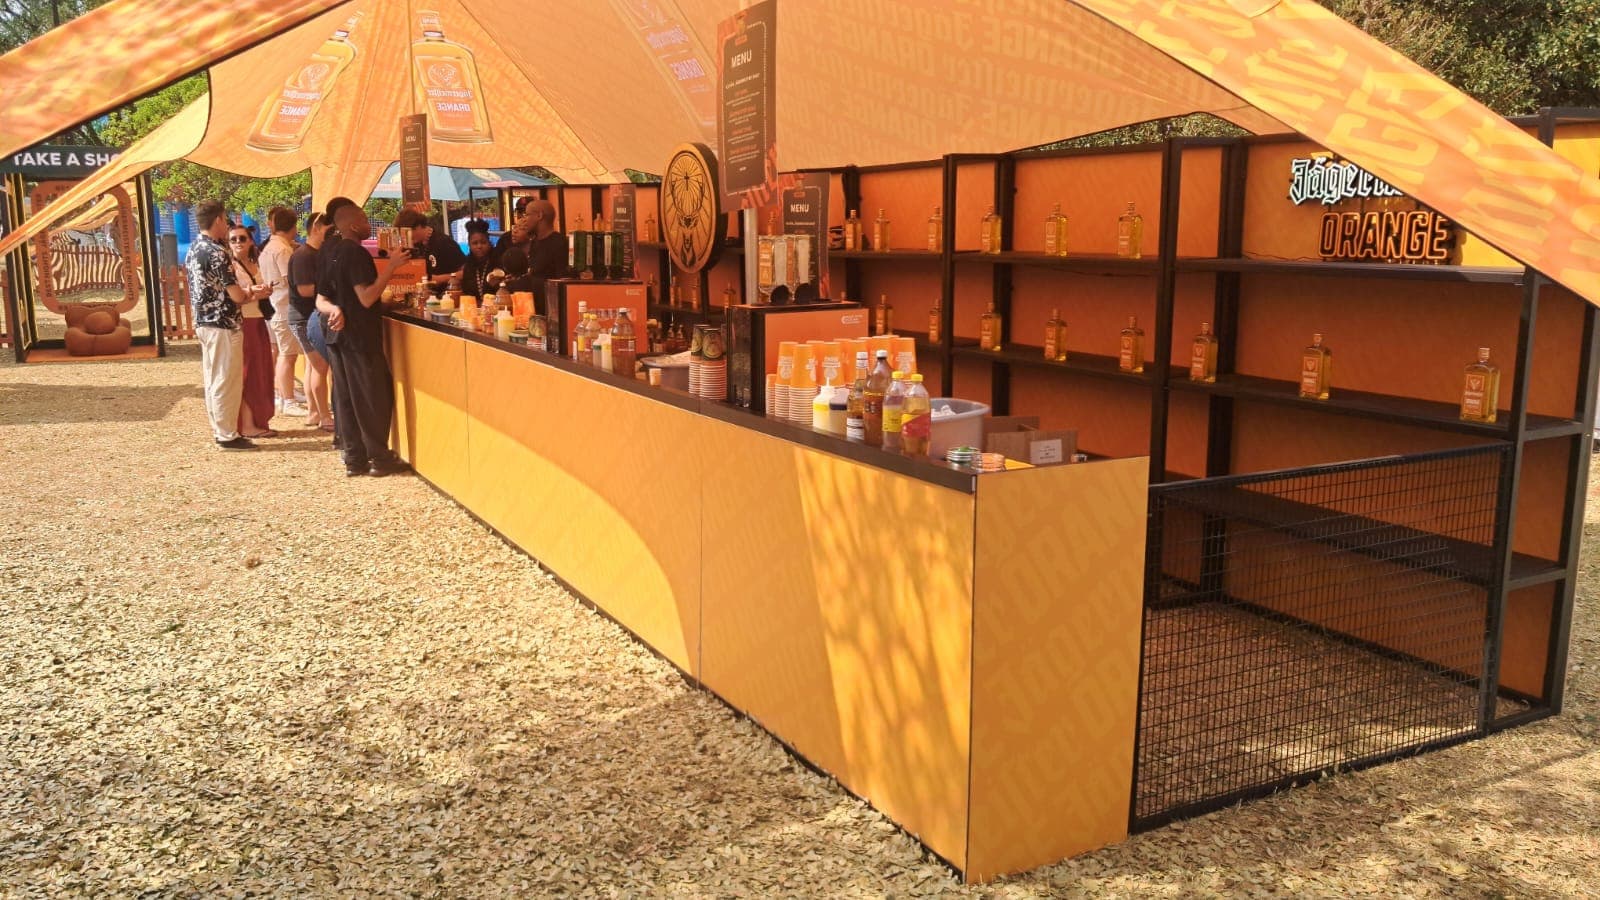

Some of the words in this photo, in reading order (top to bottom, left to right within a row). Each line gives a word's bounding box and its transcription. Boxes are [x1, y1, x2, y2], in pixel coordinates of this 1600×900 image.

[731, 49, 752, 68] MENU
[14, 153, 62, 166] TAKE
[66, 153, 81, 166] A
[790, 203, 809, 213] MENU
[1319, 211, 1448, 259] ORANGE
